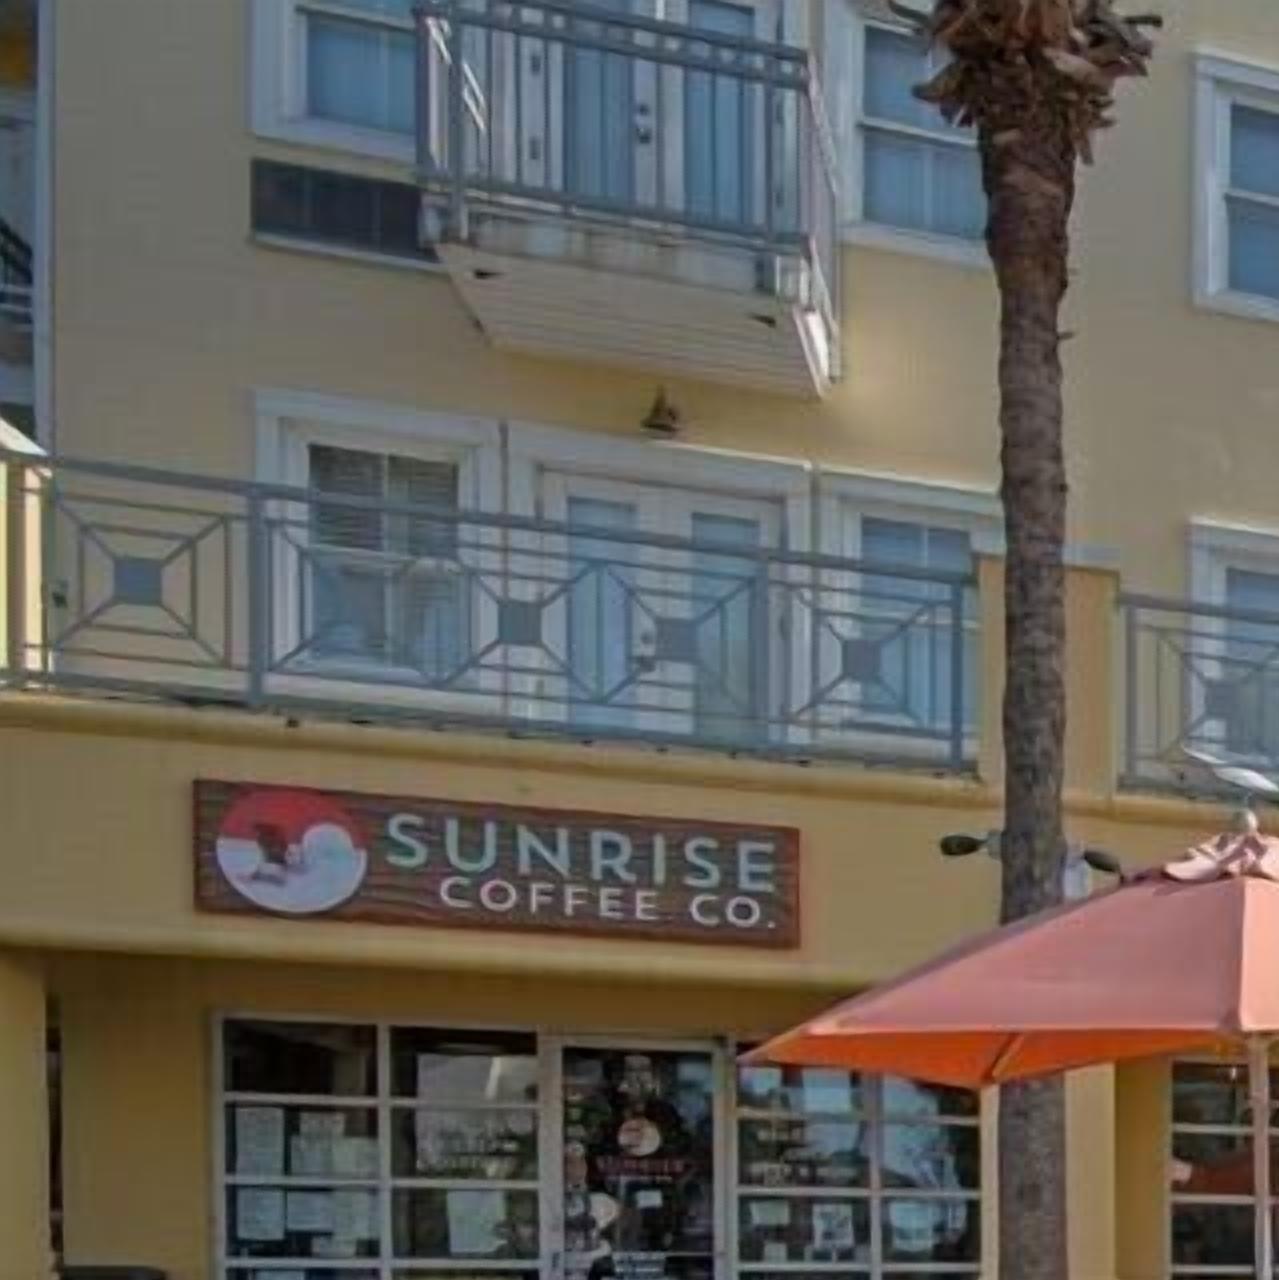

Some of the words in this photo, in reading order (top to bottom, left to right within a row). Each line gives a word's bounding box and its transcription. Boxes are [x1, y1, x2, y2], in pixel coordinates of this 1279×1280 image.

[384, 812, 776, 894] SUNRISE
[438, 875, 661, 921] COFFEE
[689, 893, 777, 929] CO.
